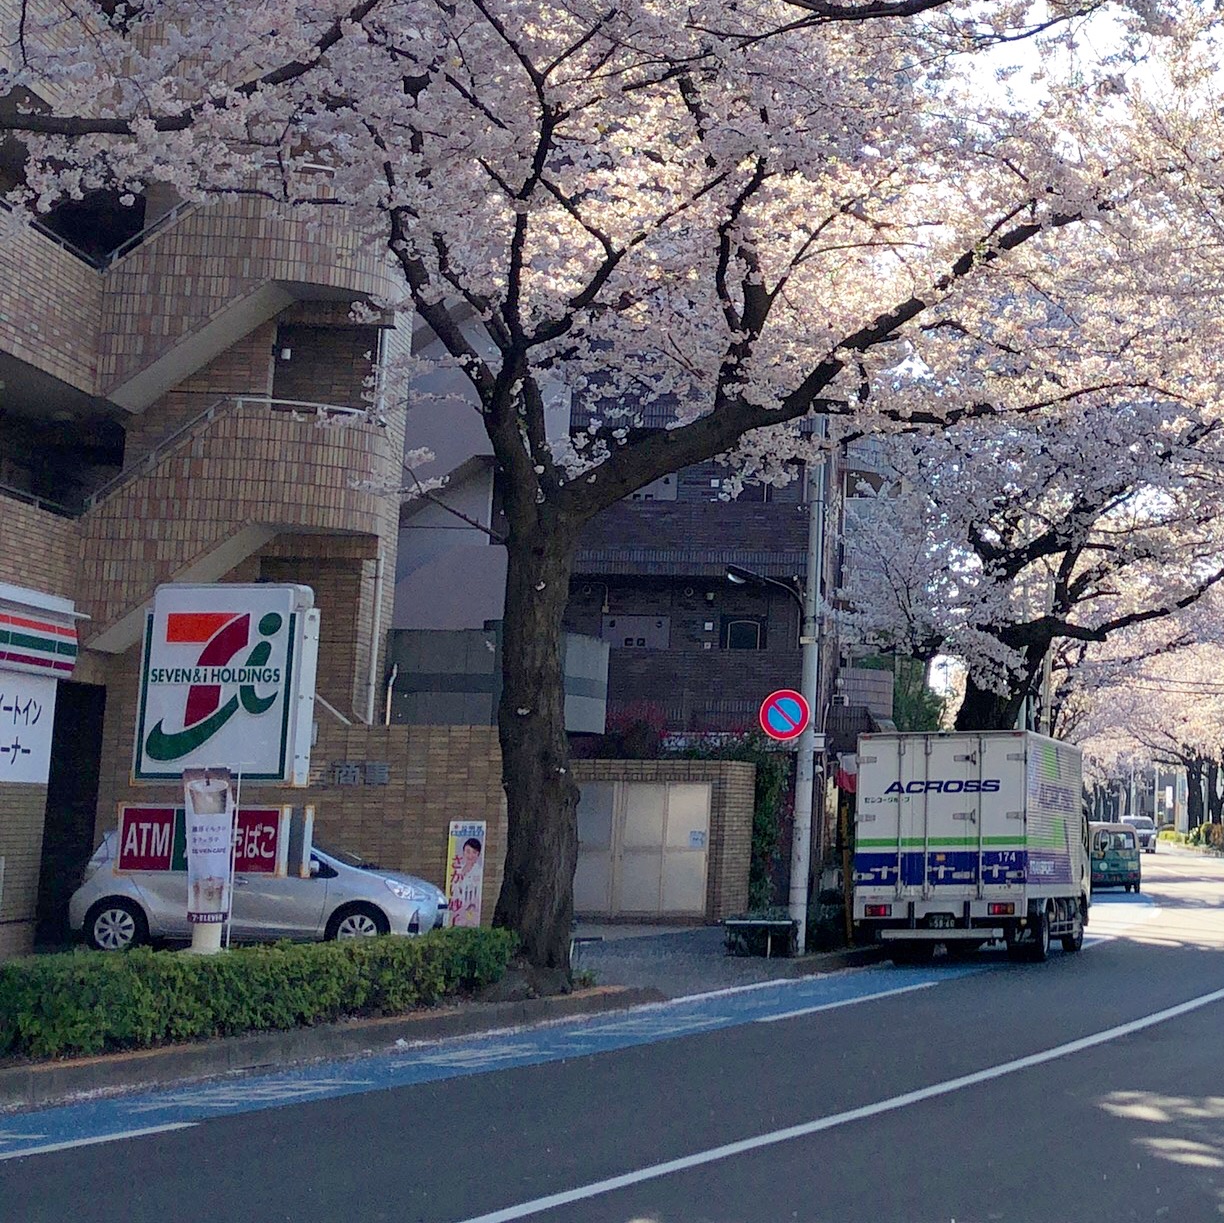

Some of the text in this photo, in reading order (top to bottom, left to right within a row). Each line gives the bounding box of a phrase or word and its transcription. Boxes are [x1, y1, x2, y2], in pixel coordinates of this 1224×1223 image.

[211, 667, 280, 684] HOLDINGS
[884, 779, 1001, 795] ACROSS
[123, 822, 171, 858] ATM
[998, 851, 1016, 863] 174
